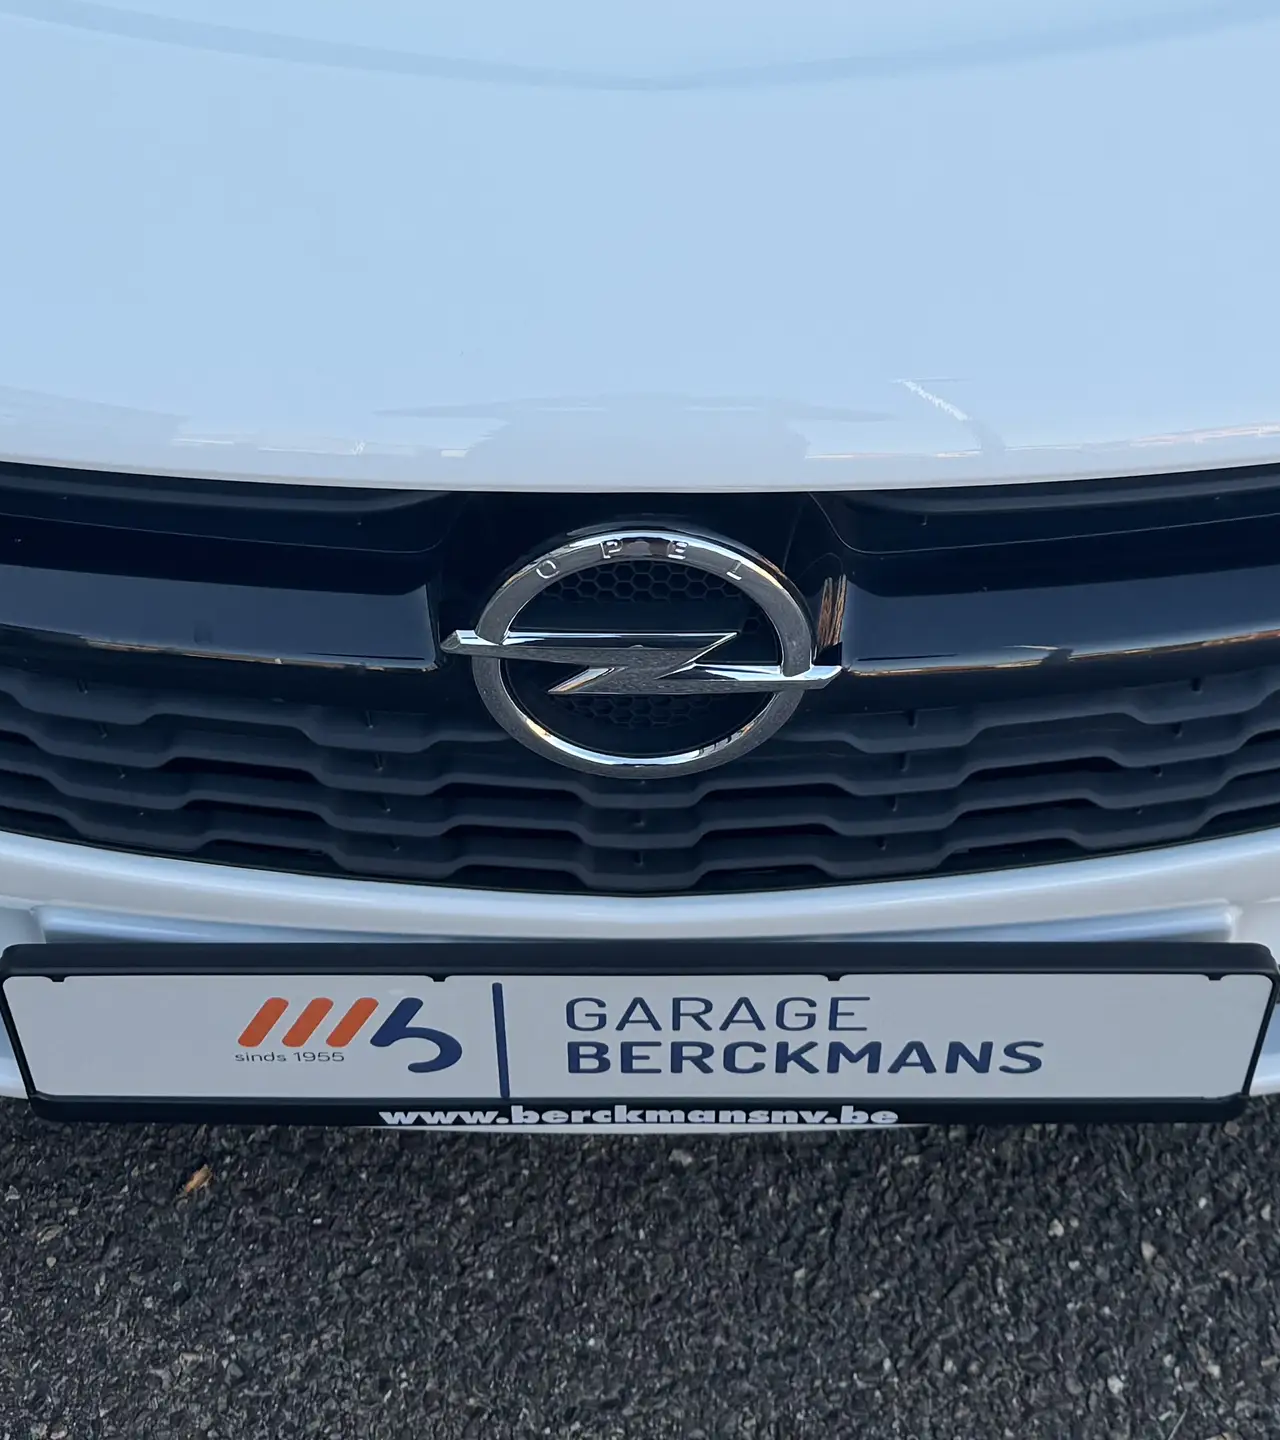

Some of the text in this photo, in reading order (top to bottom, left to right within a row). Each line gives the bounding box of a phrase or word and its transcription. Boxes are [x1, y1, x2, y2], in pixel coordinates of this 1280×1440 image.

[565, 996, 871, 1032] GARAGE
[235, 1051, 345, 1063] sinds 1955
[566, 1040, 1045, 1075] BERCKMANS
[378, 1104, 900, 1125] www.berckmansnv.be
